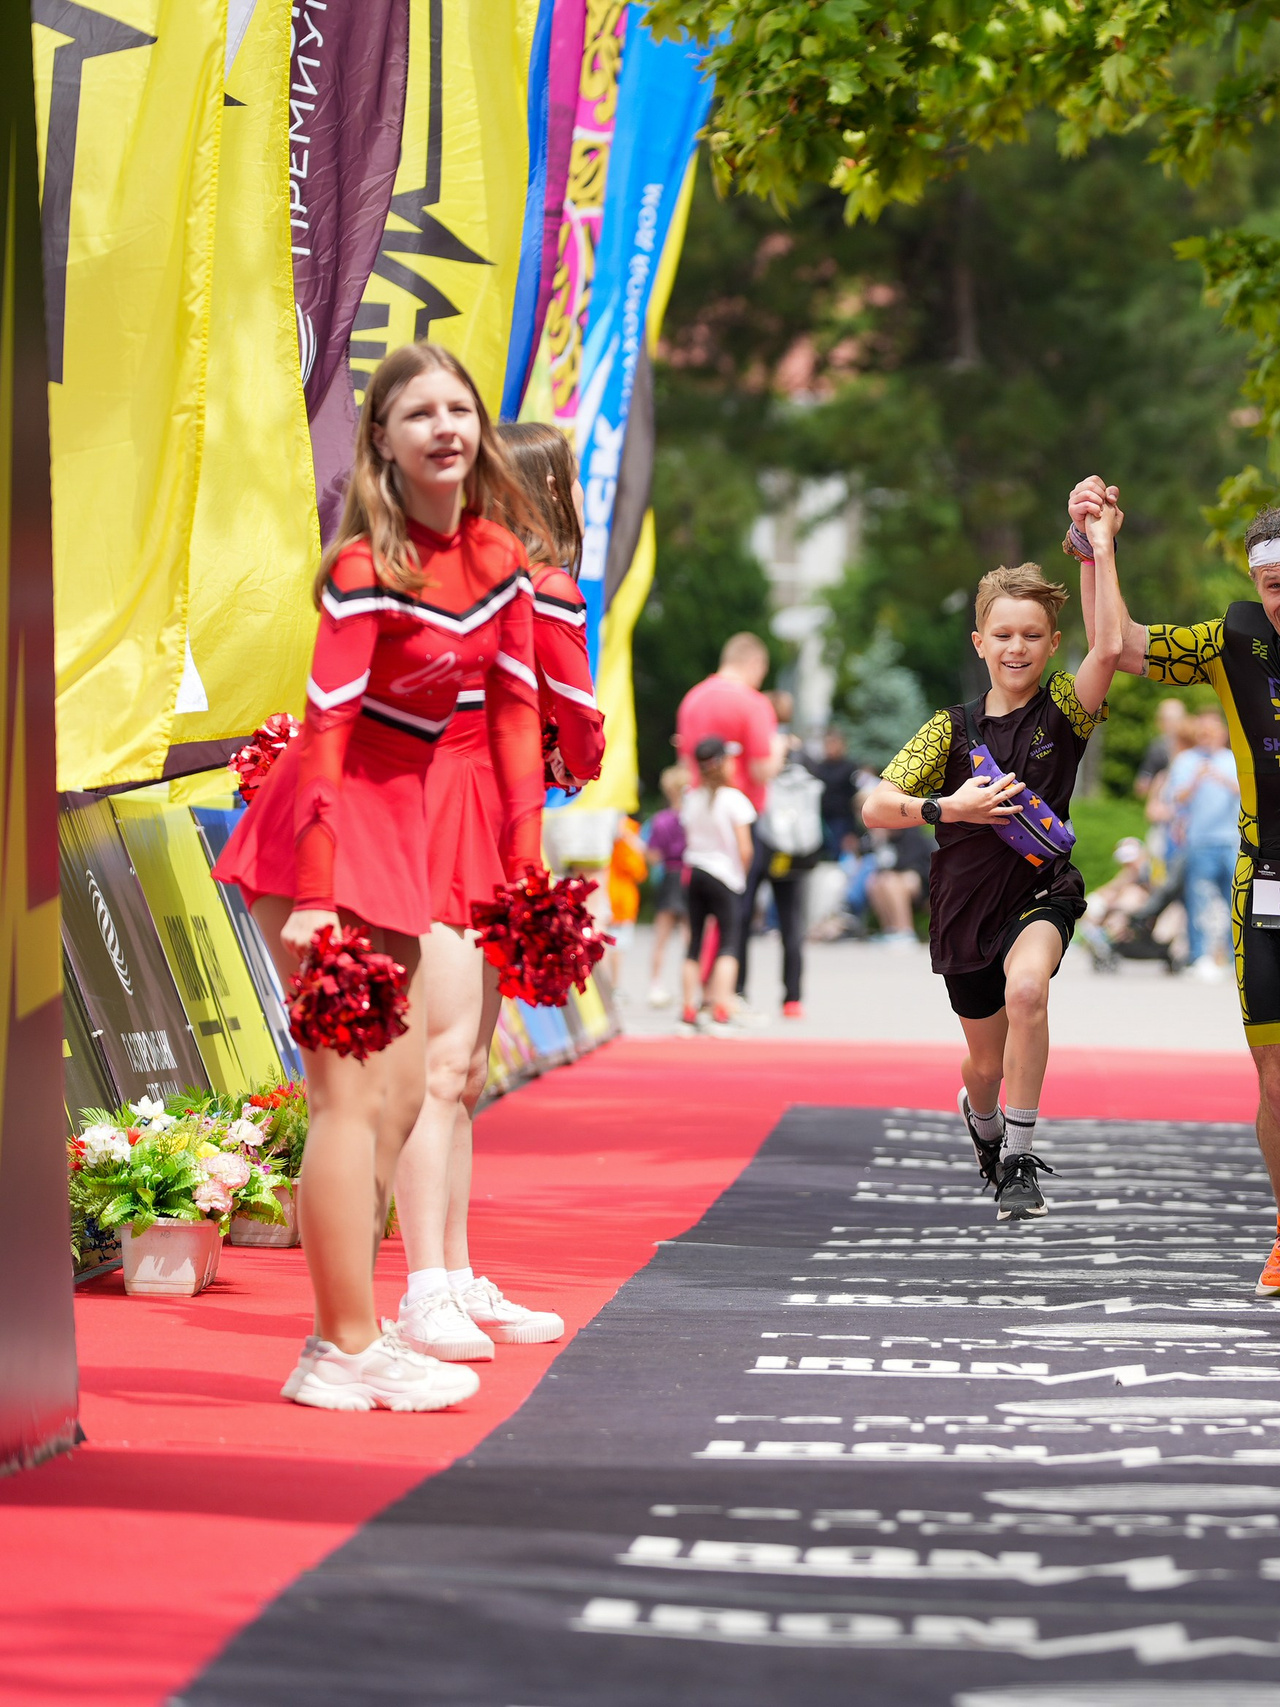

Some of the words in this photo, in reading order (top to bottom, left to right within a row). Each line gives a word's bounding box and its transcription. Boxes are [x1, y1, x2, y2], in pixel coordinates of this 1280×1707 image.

[1036, 748, 1052, 760] TEAM
[120, 1029, 178, 1073] ГАЗПРОМБАНК
[789, 1294, 1046, 1305] IRON
[755, 1355, 1049, 1374] IRON
[705, 1440, 1049, 1456] IRON
[628, 1535, 1042, 1571] IRON
[582, 1597, 1039, 1643] IRON
